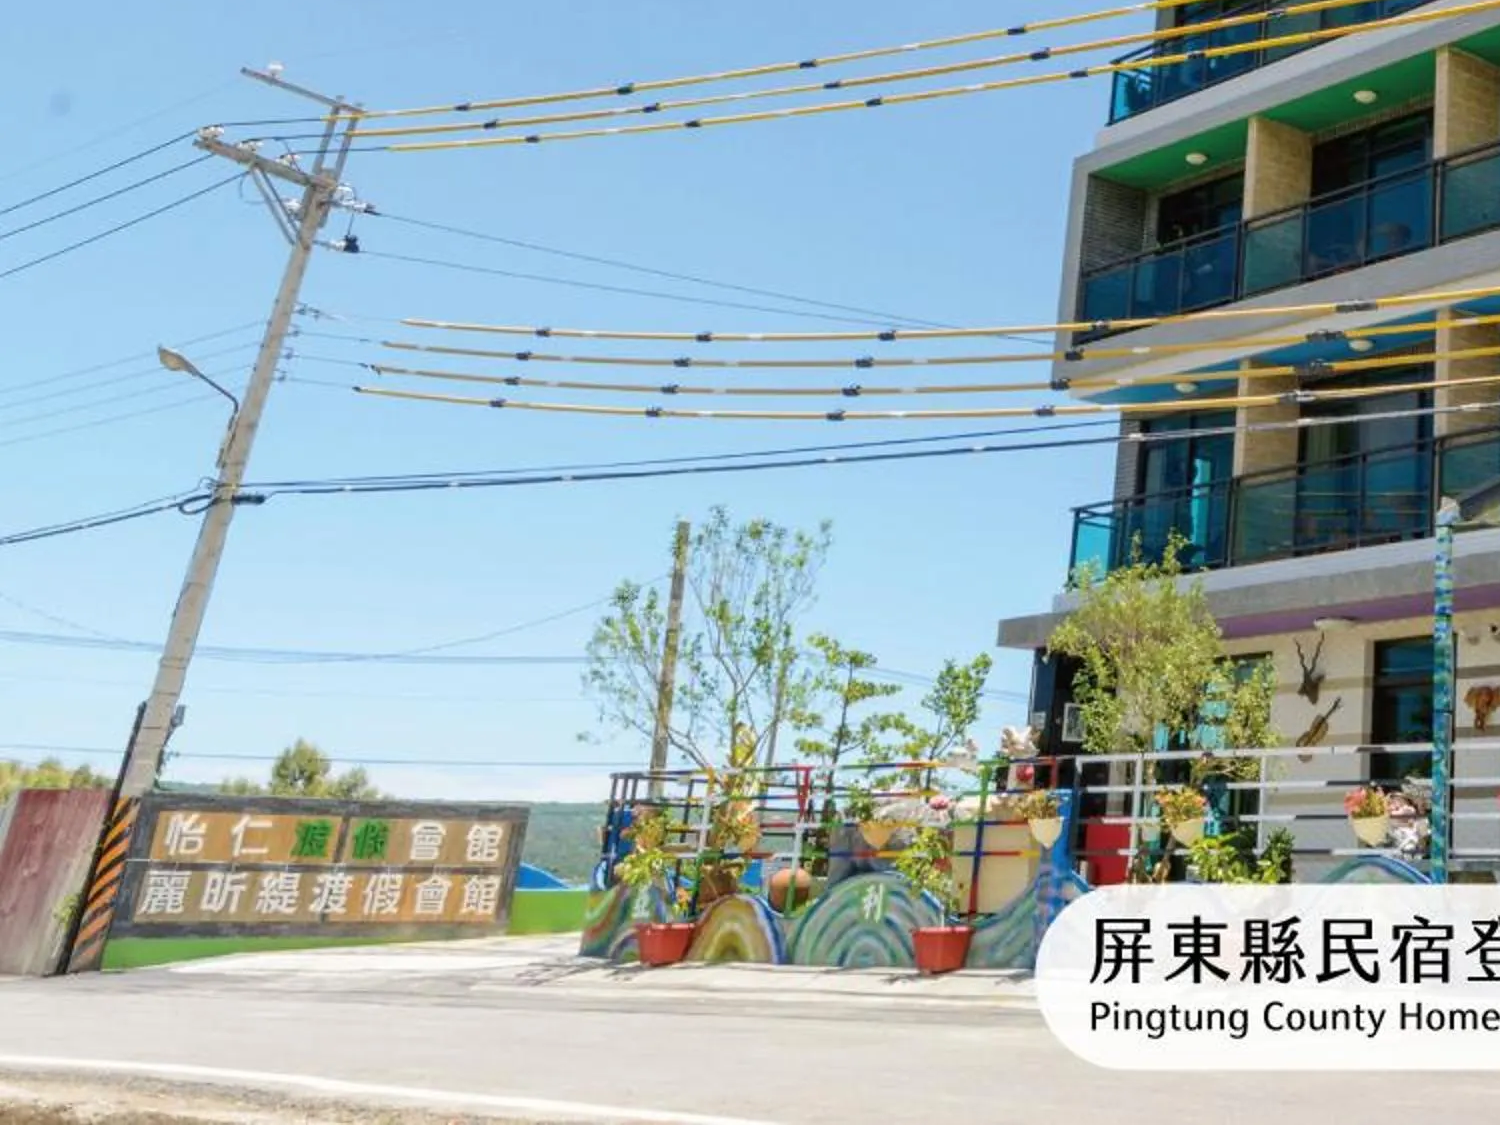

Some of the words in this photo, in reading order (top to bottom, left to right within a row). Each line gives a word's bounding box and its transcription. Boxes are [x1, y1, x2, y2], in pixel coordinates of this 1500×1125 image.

[137, 869, 502, 916] 麗昕緹渡假會館
